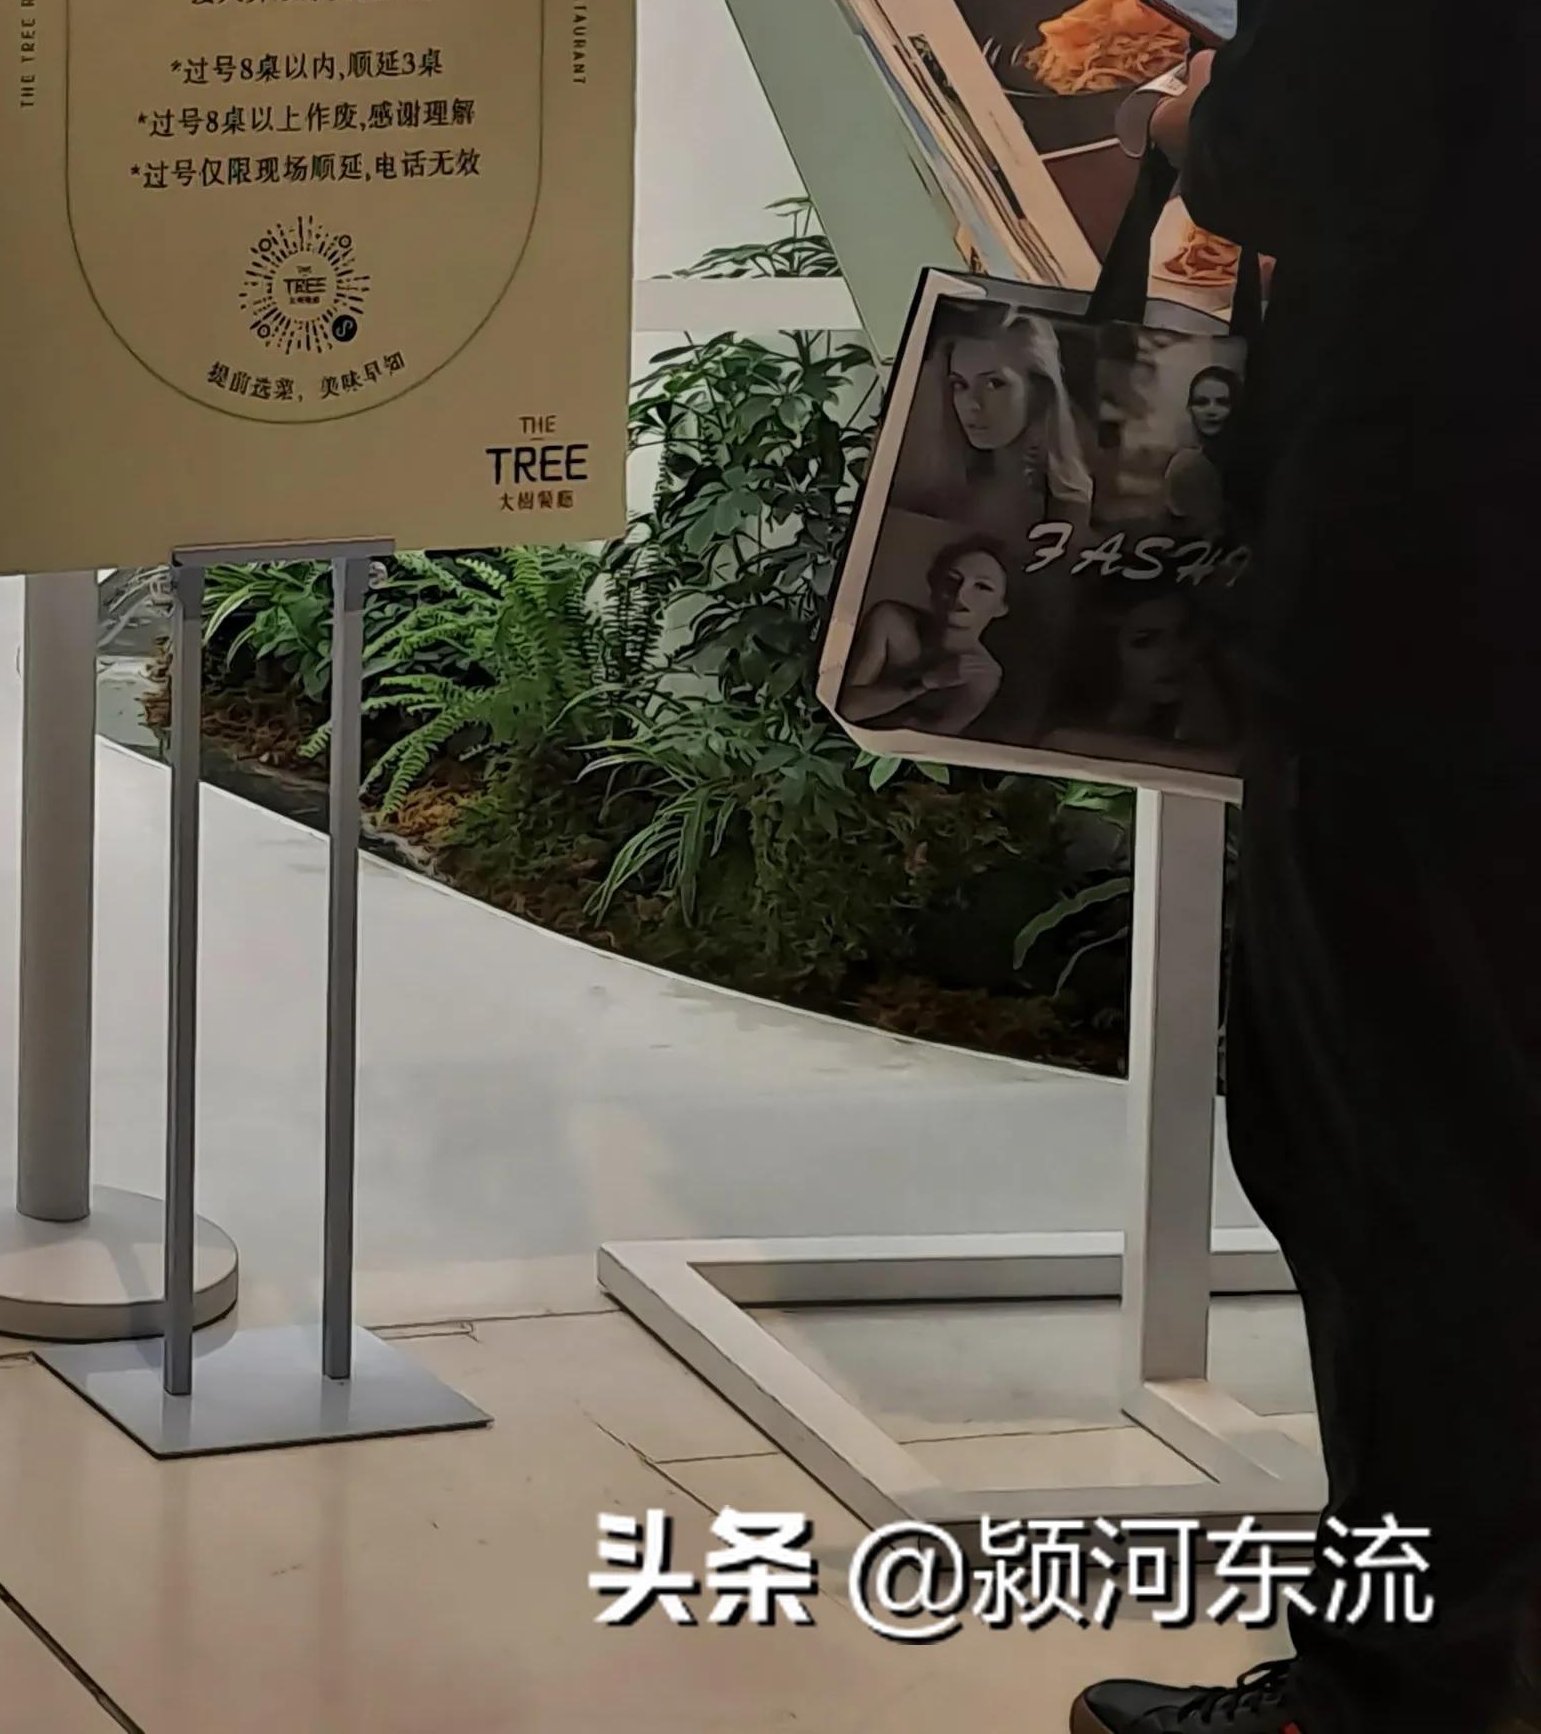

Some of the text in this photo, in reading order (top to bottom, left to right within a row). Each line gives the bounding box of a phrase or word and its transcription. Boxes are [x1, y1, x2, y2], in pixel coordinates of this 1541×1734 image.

[20, 18, 36, 63] TREE
[20, 74, 36, 108] THE
[518, 414, 557, 434] THE
[485, 443, 590, 486] TREE
